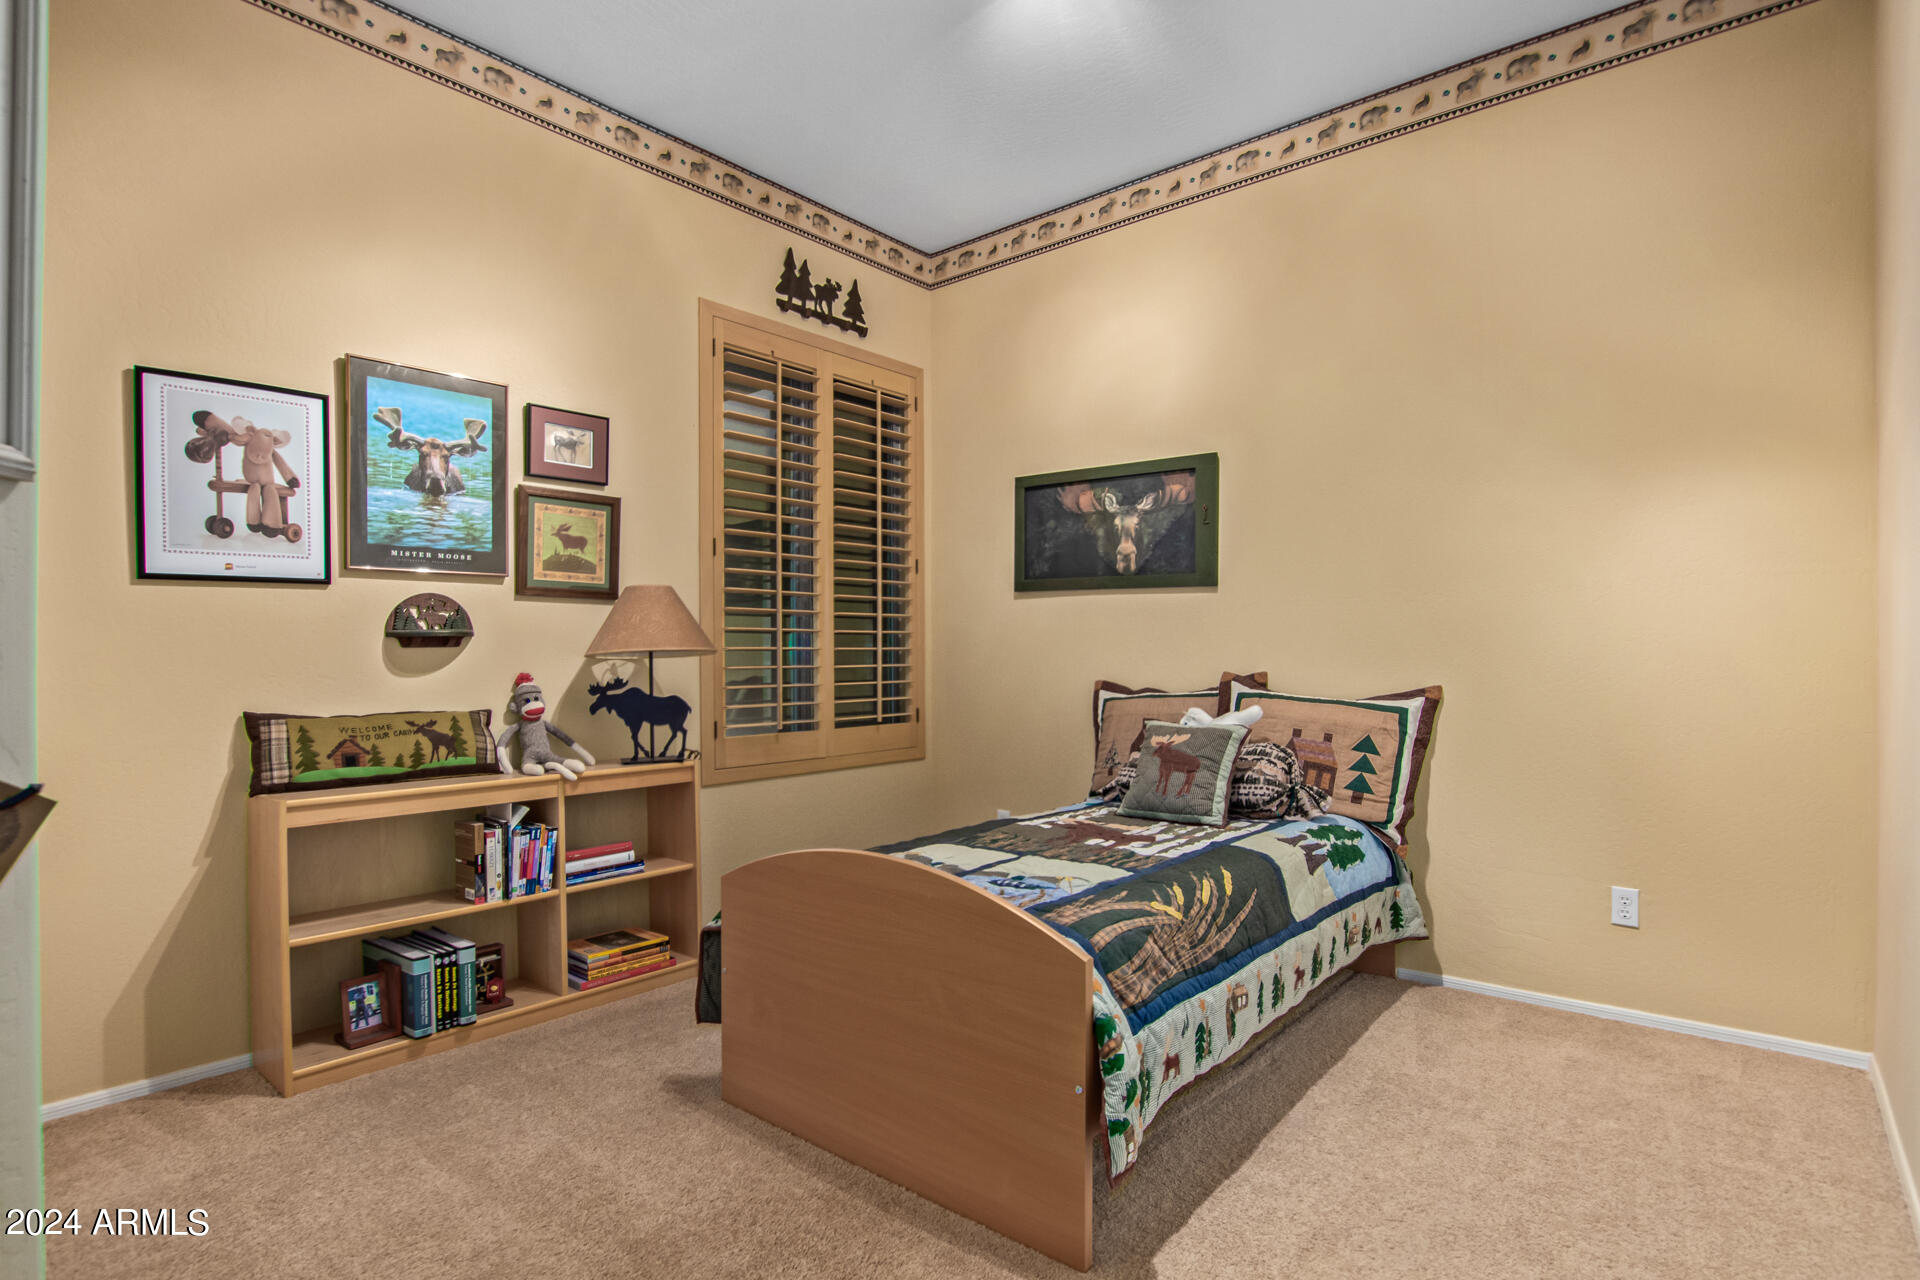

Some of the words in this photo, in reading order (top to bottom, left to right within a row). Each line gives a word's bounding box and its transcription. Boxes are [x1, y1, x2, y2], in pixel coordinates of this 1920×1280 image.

[391, 550, 432, 559] MISTER
[437, 553, 472, 561] MOOSE
[338, 724, 393, 734] WELCOME
[360, 734, 371, 742] TO
[374, 731, 390, 741] OUR
